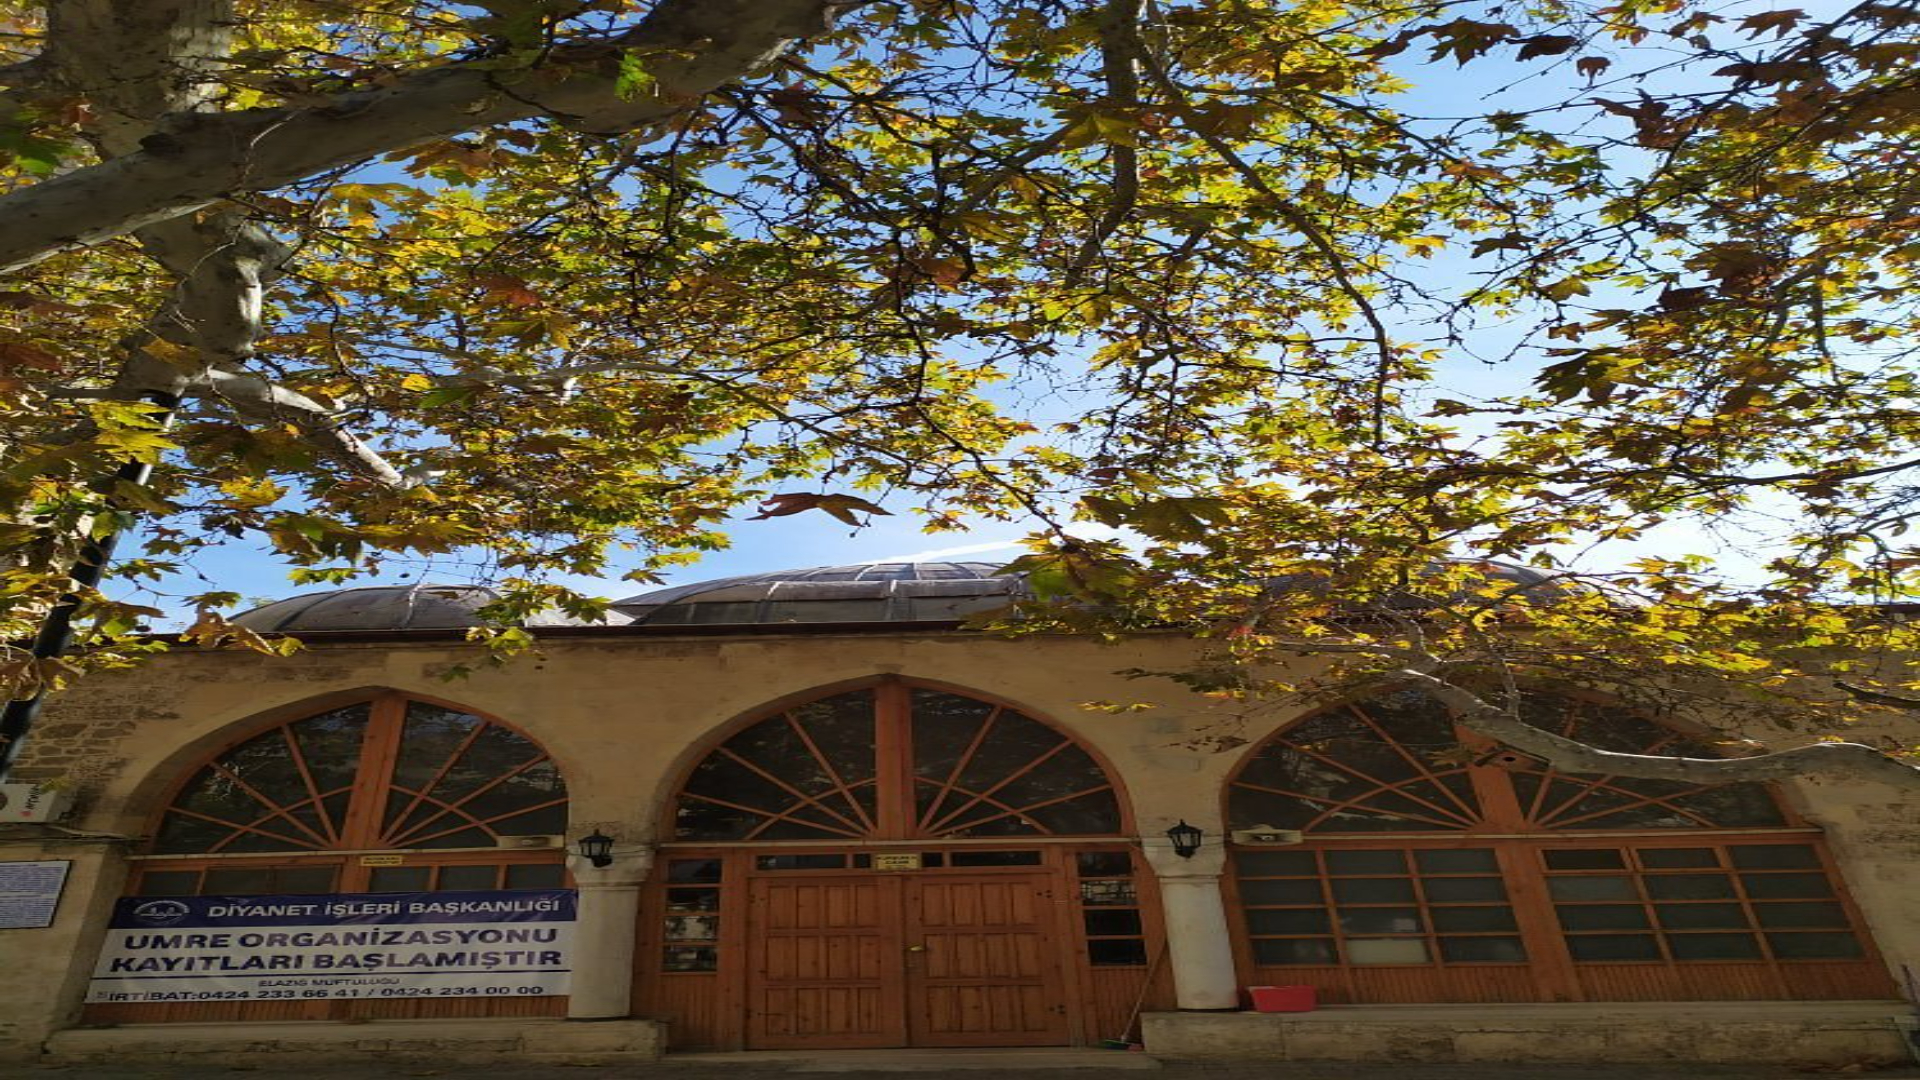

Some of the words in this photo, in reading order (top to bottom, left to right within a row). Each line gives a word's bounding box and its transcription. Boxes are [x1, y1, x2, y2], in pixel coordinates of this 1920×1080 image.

[207, 903, 318, 918] DİYANET
[324, 901, 400, 919] İŞLERİ
[408, 897, 560, 917] BAŞKANLIĞI
[124, 932, 231, 950] UMRE
[238, 928, 558, 950] ORGANİZASYONU
[110, 954, 304, 973] KAYITLARI
[312, 950, 562, 971] BAŞLAMIŞTIR
[257, 989, 296, 999] 233
[335, 988, 359, 998] 41
[381, 987, 433, 997] 0424
[439, 987, 478, 996] 234
[485, 986, 511, 995] 00
[516, 986, 544, 995] 00
